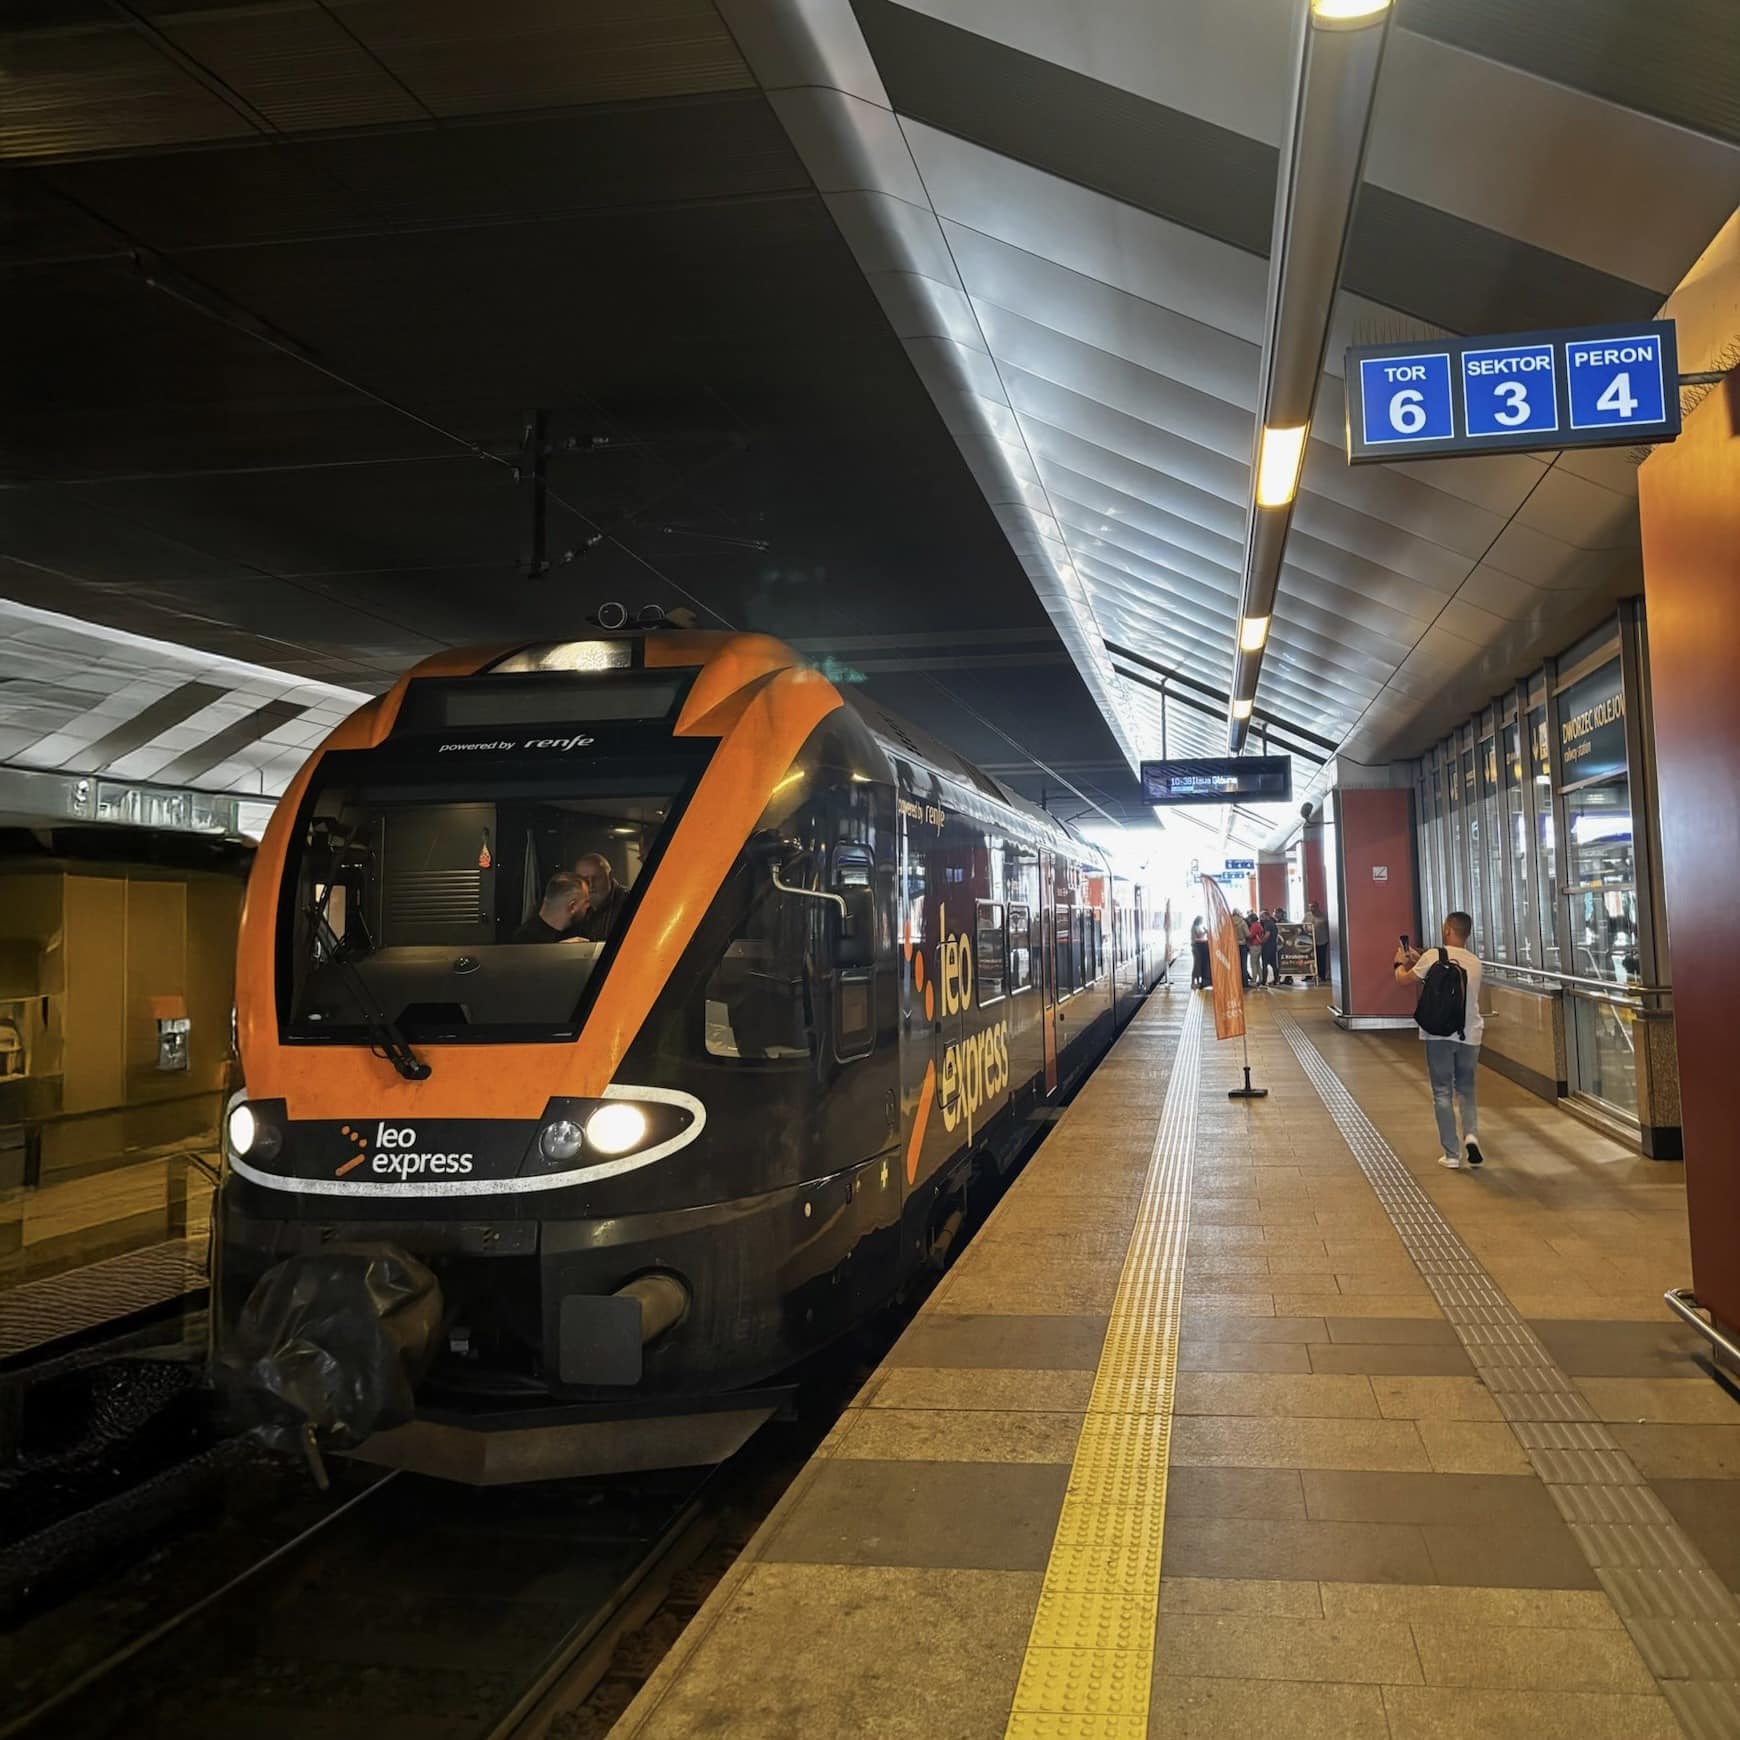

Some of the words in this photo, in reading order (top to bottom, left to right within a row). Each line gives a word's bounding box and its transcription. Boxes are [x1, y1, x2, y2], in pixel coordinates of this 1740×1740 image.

[1467, 355, 1551, 376] SEKTOR
[1574, 346, 1652, 368] PERON
[1384, 366, 1427, 383] TOR
[1493, 381, 1531, 426] 3
[1596, 372, 1638, 418] 4
[1388, 389, 1427, 434] 6
[1562, 709, 1594, 744] DWORZEC
[438, 741, 498, 752] powered
[498, 741, 516, 751] by
[524, 734, 595, 752] renfe
[939, 902, 973, 1018] leo
[942, 1018, 1009, 1148] express
[376, 1121, 417, 1148] leo
[372, 1153, 473, 1180] express
